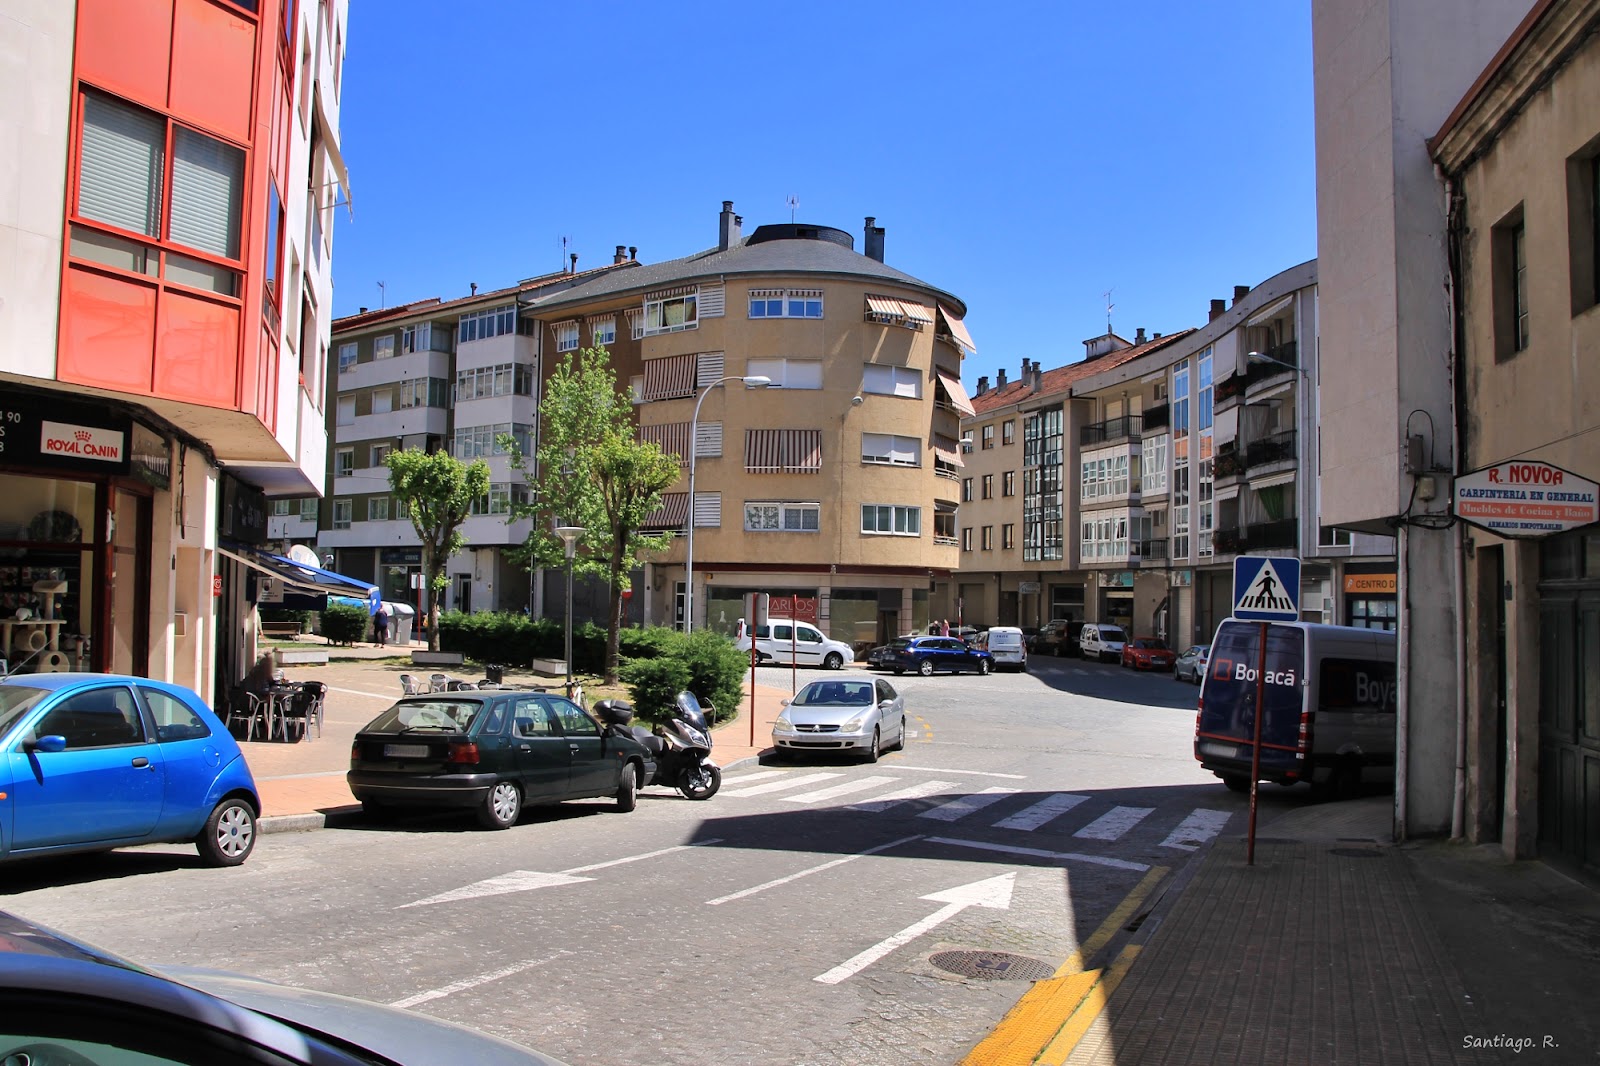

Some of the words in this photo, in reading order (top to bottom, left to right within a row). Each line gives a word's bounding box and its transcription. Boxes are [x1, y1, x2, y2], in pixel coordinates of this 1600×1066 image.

[7, 411, 21, 423] 90
[46, 438, 81, 454] ROYAL
[83, 443, 118, 458] CANIN
[1488, 468, 1503, 484] R.
[1509, 465, 1563, 486] NOVOA
[1459, 488, 1527, 500] CARPINTERIA
[1529, 491, 1544, 501] EN
[1546, 492, 1594, 503] GENERAL
[1462, 503, 1502, 514] Muebles
[1504, 505, 1517, 515] de
[1519, 506, 1553, 517] Cocina
[1555, 510, 1562, 519] y
[1355, 580, 1388, 589] CENTRO
[770, 599, 814, 612] ARLOS
